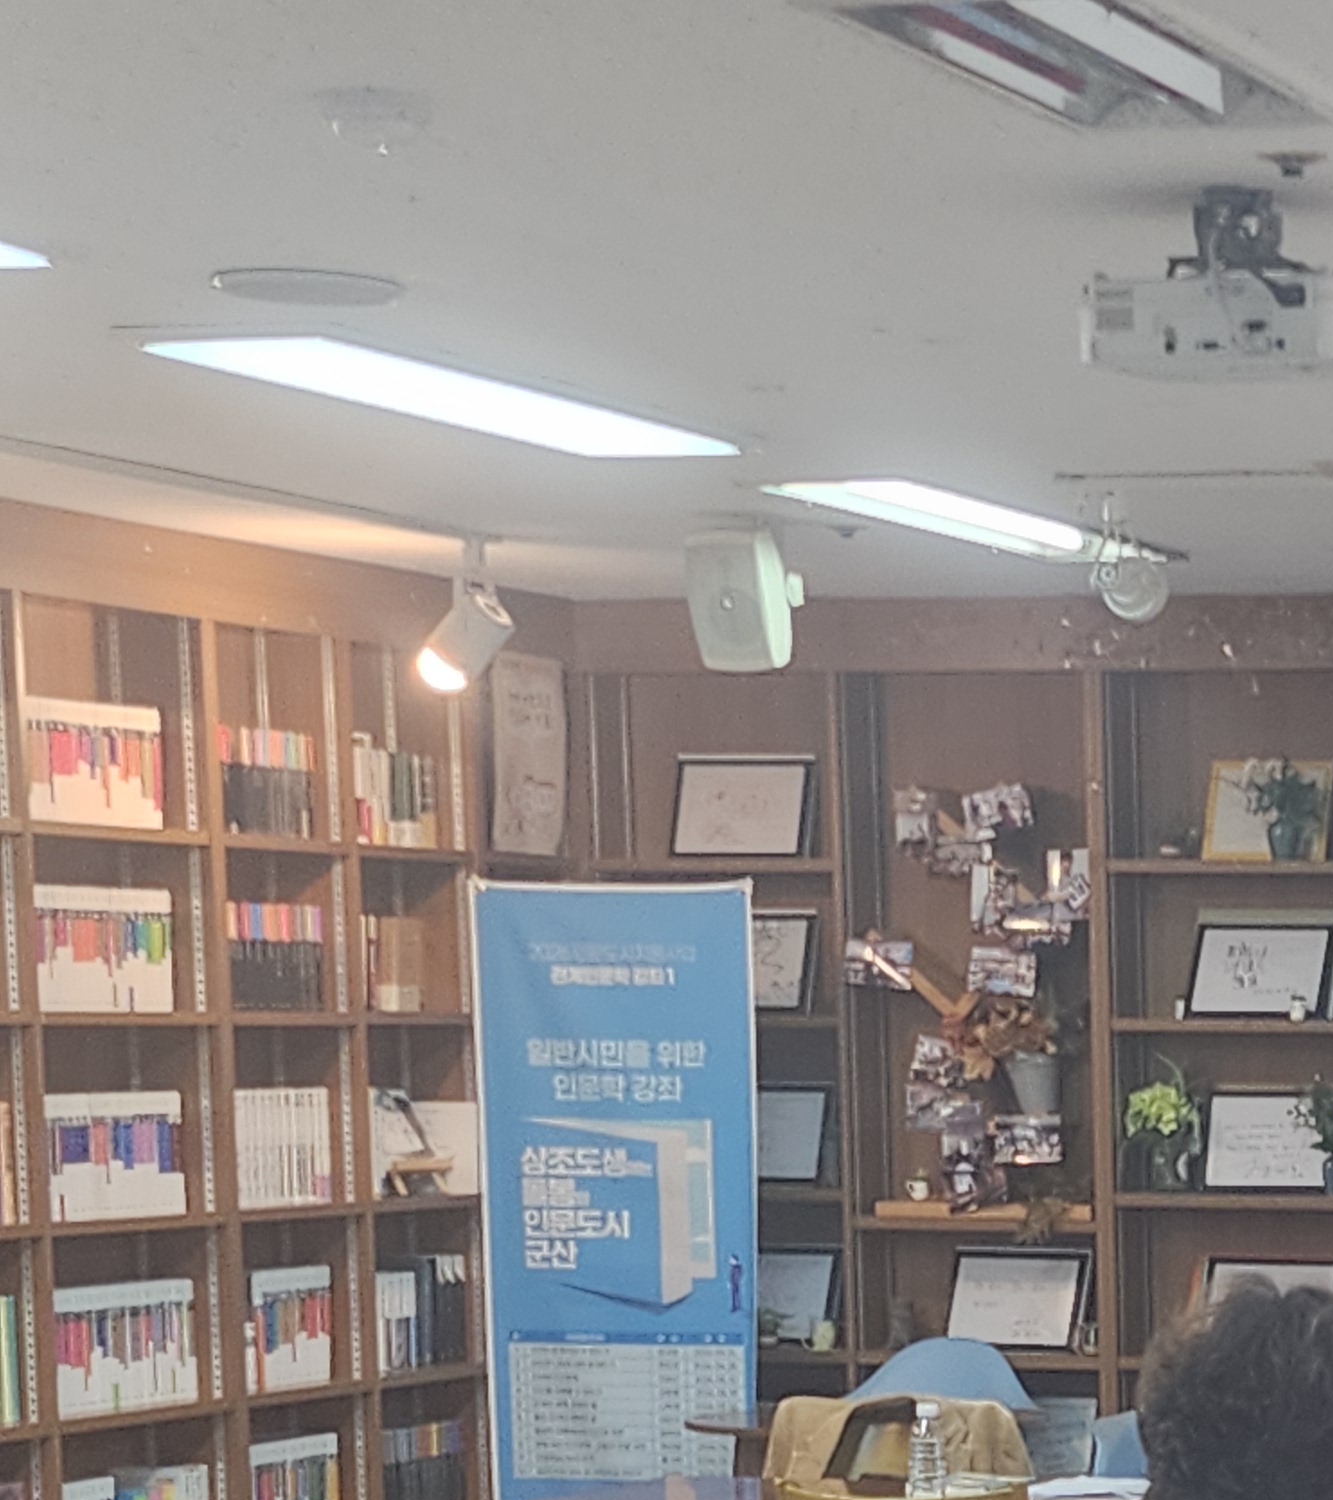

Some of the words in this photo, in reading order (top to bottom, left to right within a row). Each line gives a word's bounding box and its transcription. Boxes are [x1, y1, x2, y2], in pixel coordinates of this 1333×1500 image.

[527, 1038, 650, 1068] 일반시민을
[657, 1040, 706, 1068] 위한
[553, 1073, 624, 1102] 인문학
[631, 1074, 682, 1102] 강좌
[524, 1209, 630, 1239] 인문도시
[526, 1240, 578, 1270] 군산
